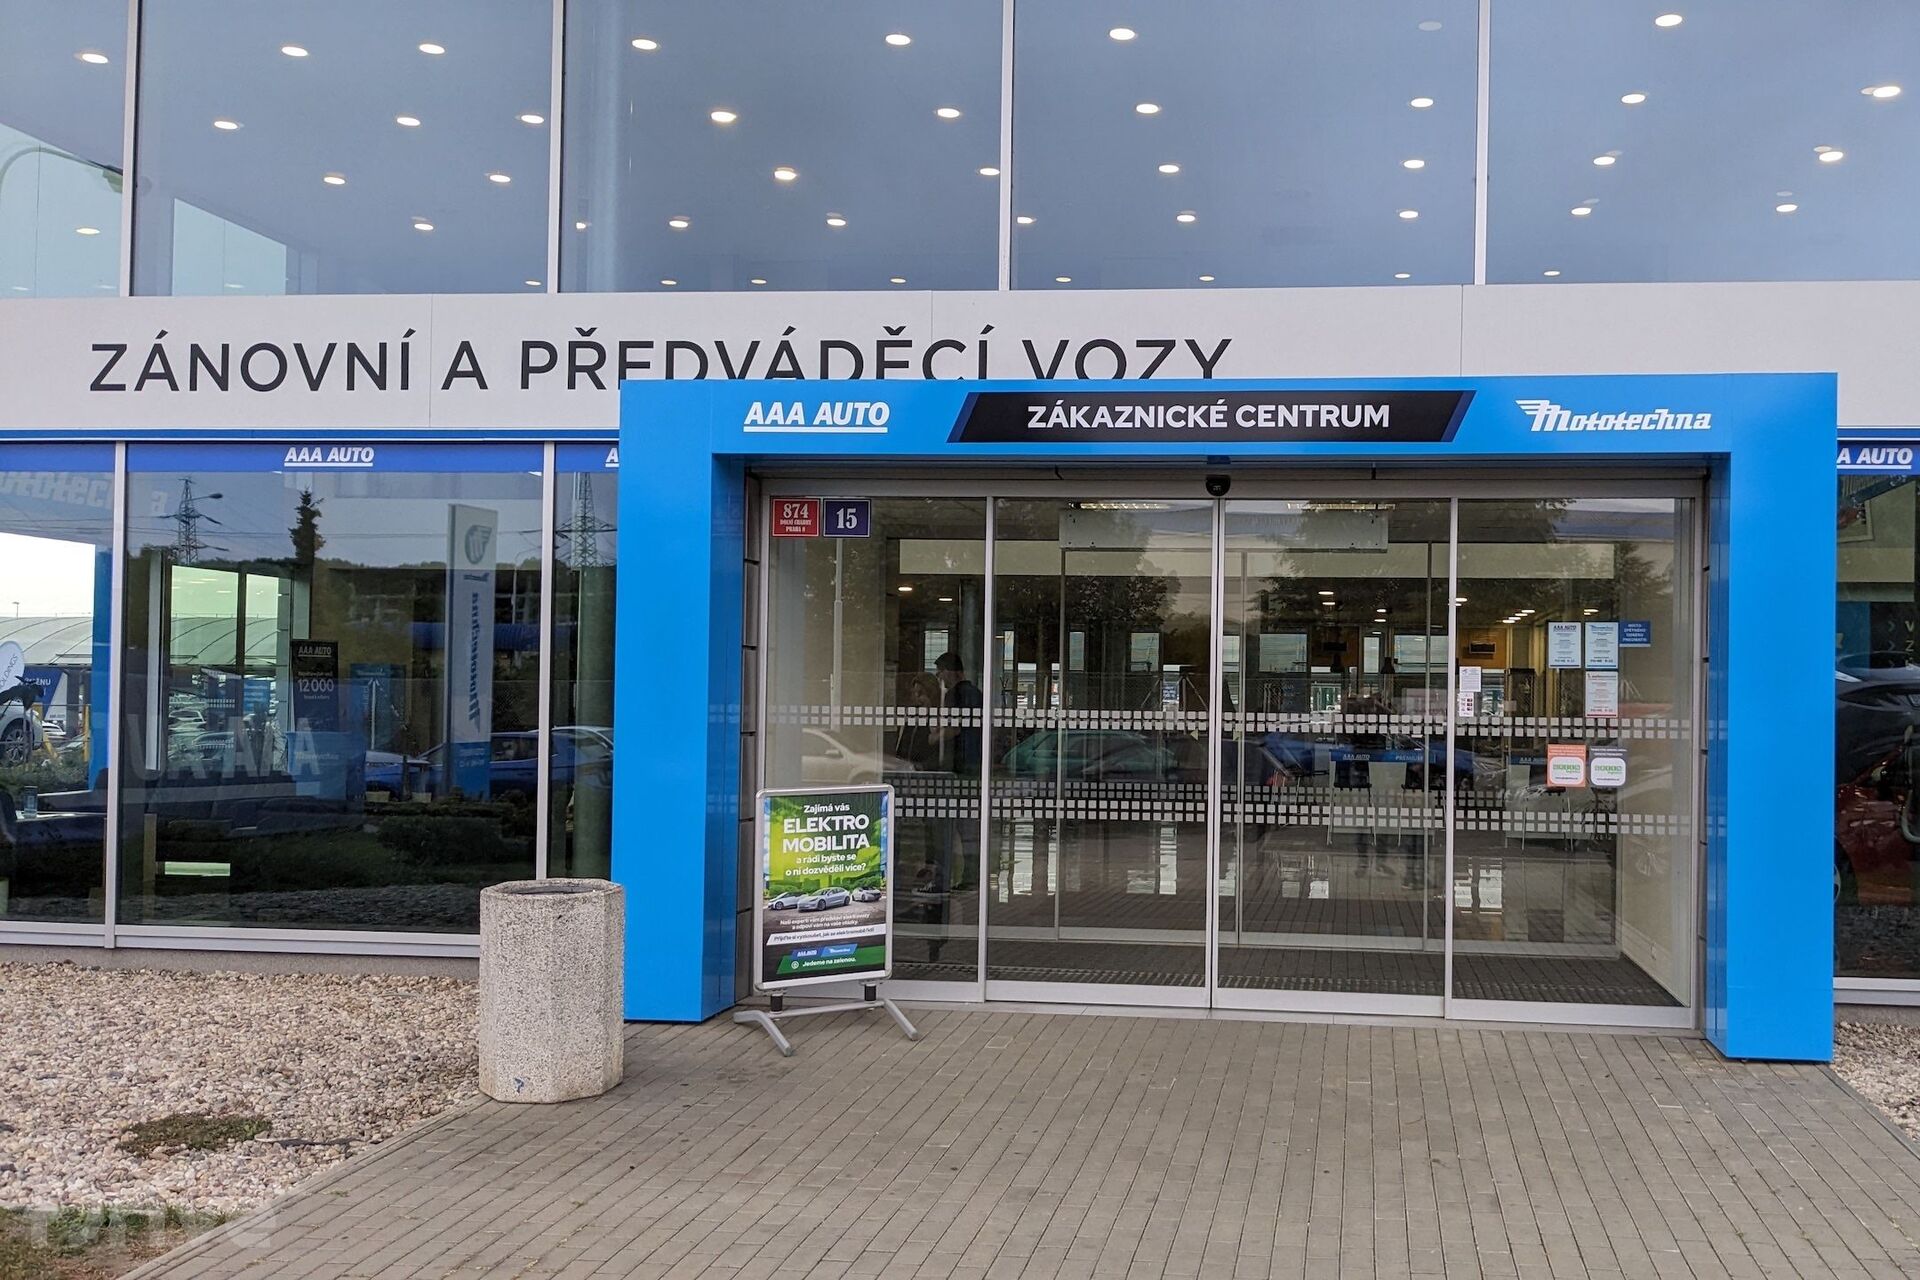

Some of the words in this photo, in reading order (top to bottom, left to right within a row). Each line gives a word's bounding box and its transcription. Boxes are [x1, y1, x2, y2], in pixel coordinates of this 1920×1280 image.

[90, 329, 416, 392] ZÁNOVNÍ
[441, 340, 488, 391] A
[520, 325, 995, 390] PŘEDVÁDĚCÍ
[1022, 338, 1232, 379] VOZY
[743, 401, 804, 425] AAA
[813, 401, 890, 426] AUTO
[1027, 399, 1228, 429] ZÁKAZNICKÉ
[1235, 403, 1390, 429] CENTRUM
[1515, 399, 1711, 432] Mototechna
[284, 447, 323, 462] AAA
[327, 447, 374, 462] AUTO
[1857, 448, 1913, 465] AUTO
[783, 503, 809, 519] 874
[836, 508, 857, 529] 15
[803, 803, 834, 814] Zajímá
[834, 803, 850, 812] vás
[783, 814, 870, 834] ELEKTRO
[783, 833, 870, 853] MOBILITA
[802, 862, 844, 875] dozvěděli
[845, 863, 867, 873] více?
[803, 853, 820, 864] rádi
[821, 853, 846, 866] byste
[846, 853, 857, 862] se
